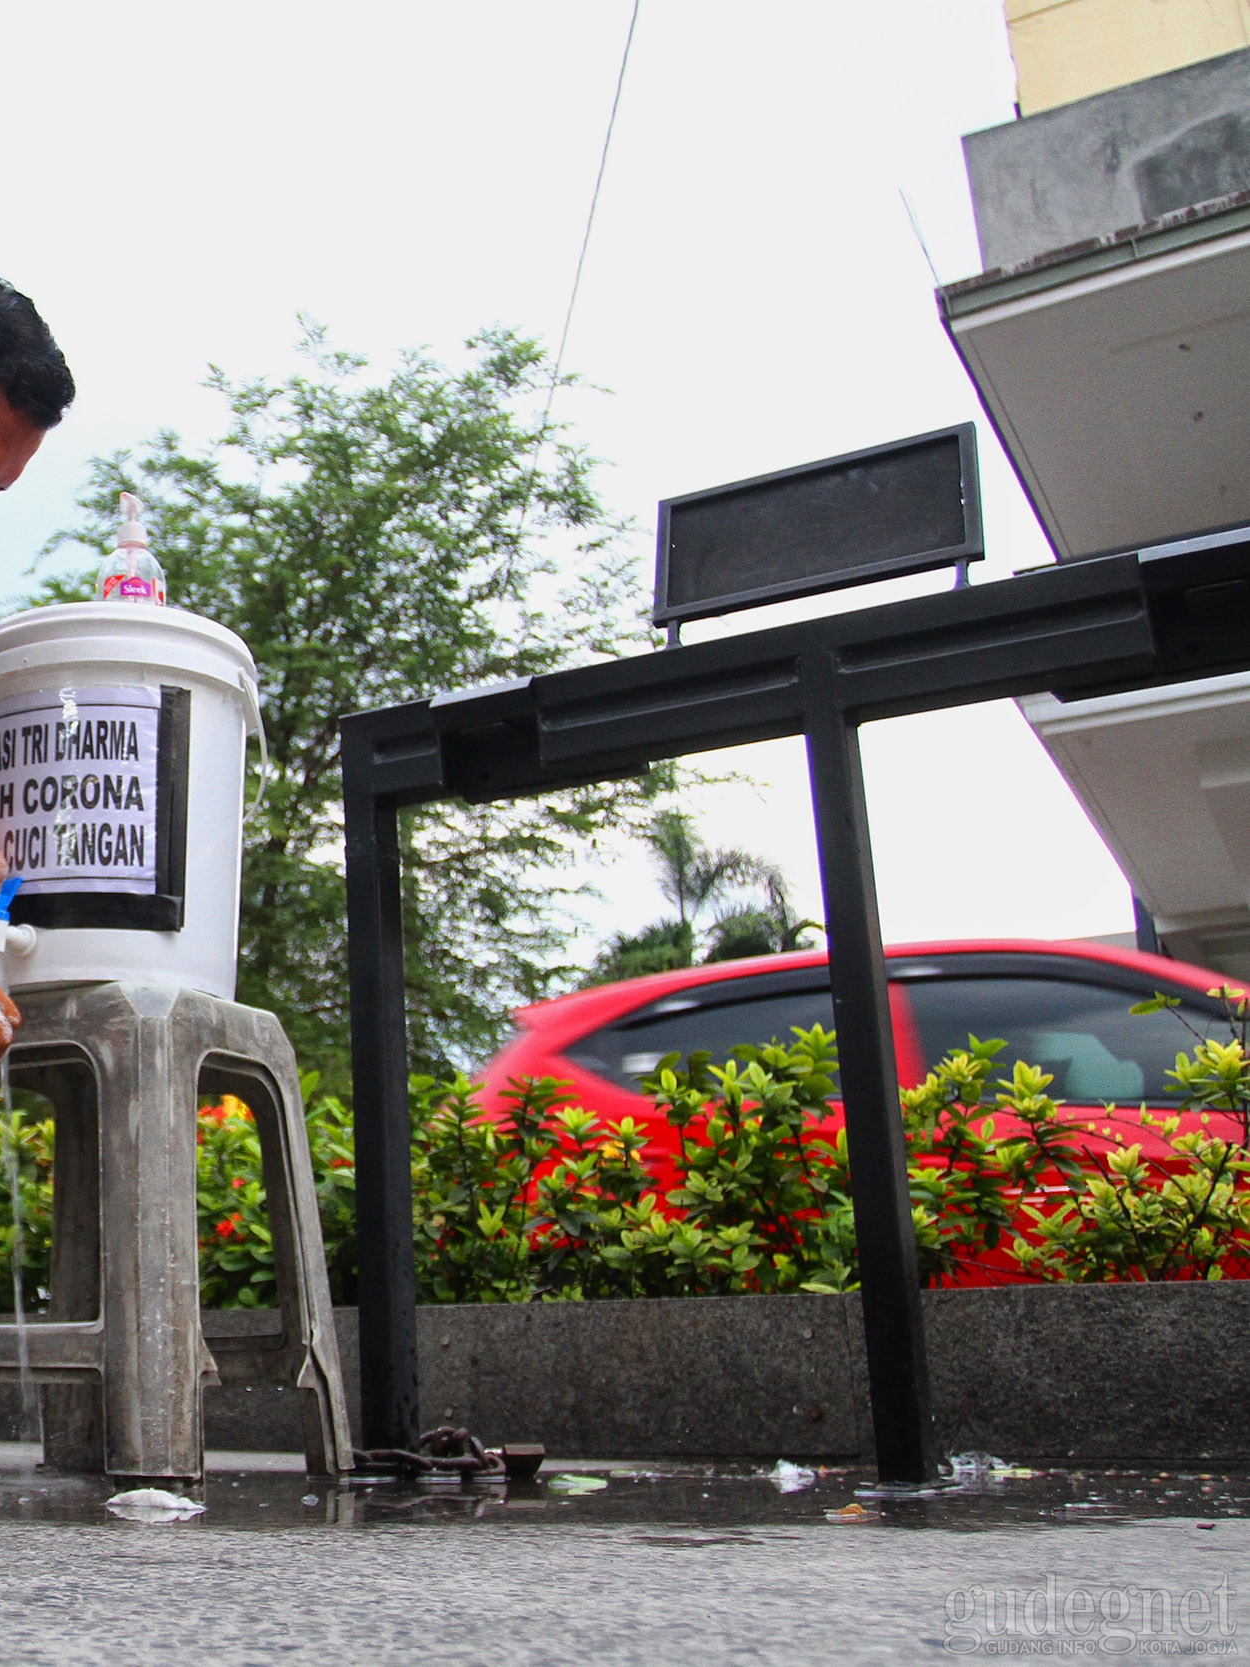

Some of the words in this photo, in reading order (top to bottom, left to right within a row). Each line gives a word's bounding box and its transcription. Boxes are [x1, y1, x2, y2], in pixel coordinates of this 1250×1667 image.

[122, 583, 148, 595] Sleek
[21, 723, 49, 766] TRI
[55, 720, 139, 762] DHARMA
[23, 774, 145, 815] CORONA
[3, 825, 47, 874] CUCI
[53, 822, 145, 868] TANGAN
